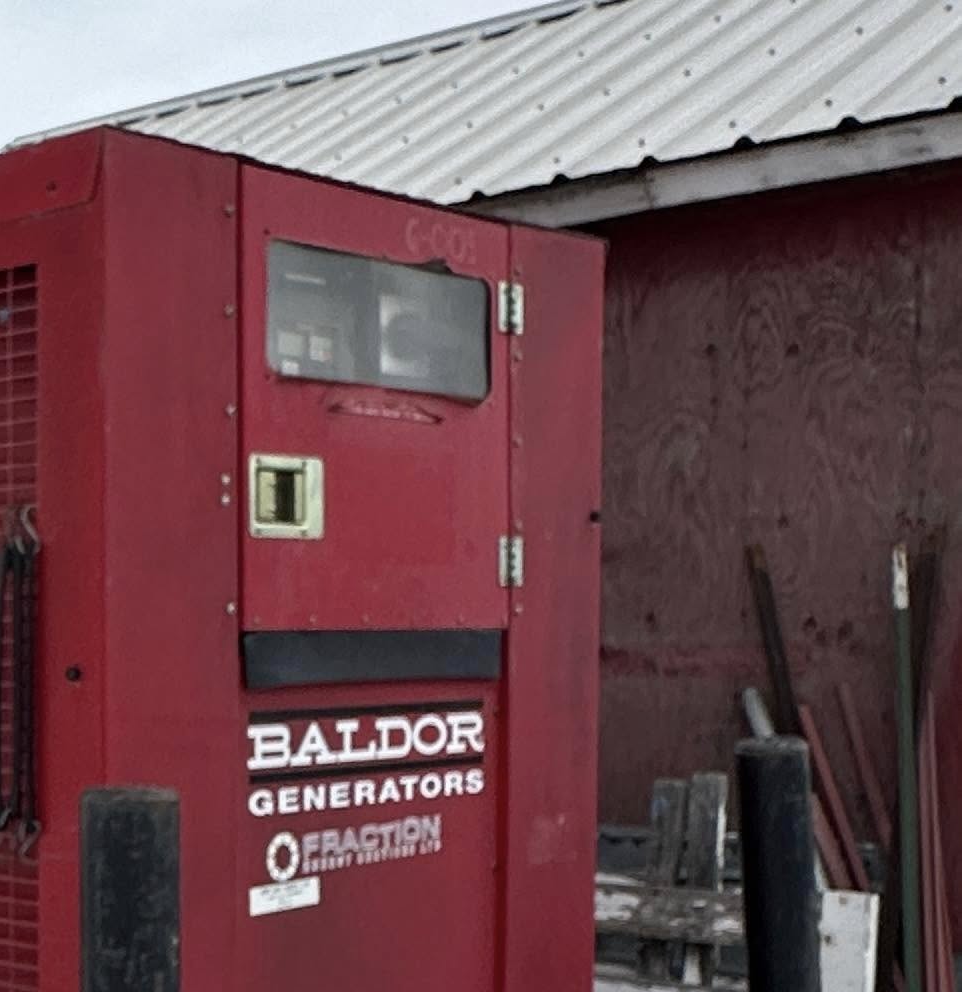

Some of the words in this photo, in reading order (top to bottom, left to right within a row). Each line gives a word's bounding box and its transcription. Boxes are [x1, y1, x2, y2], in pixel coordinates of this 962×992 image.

[246, 711, 486, 770] BALDOR
[247, 768, 485, 816] GENERATORS
[301, 813, 442, 859] FRACTION
